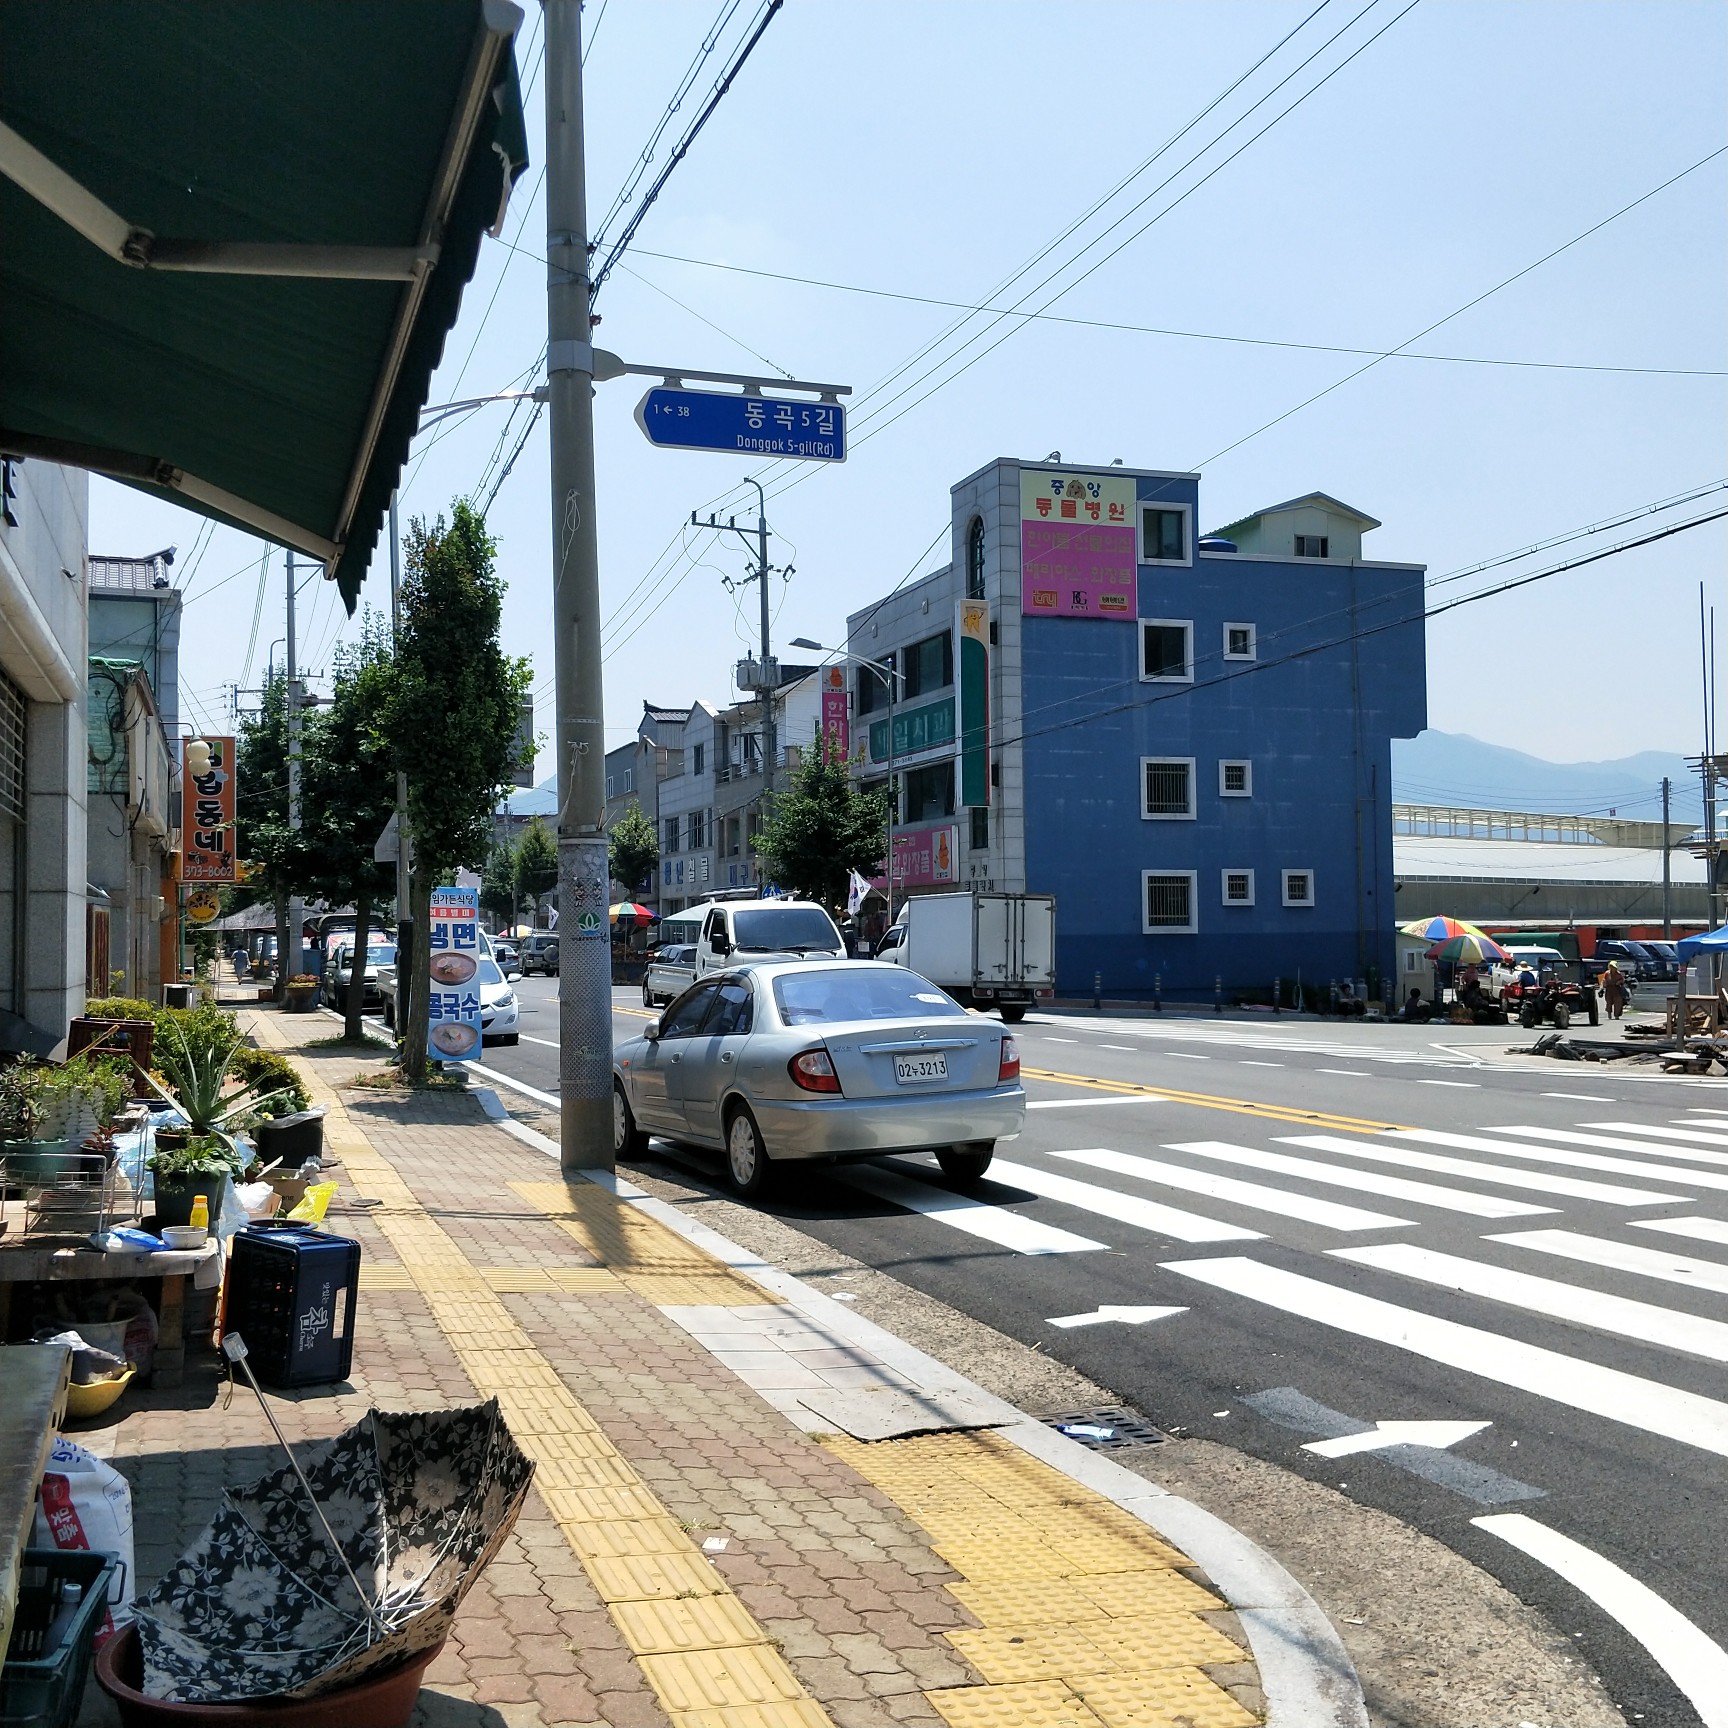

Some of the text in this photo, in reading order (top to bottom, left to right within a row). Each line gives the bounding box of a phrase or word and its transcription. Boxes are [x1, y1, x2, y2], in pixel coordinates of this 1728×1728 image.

[654, 404, 690, 417] 1 38
[737, 435, 834, 458] Donggok 5-gil(Rd)
[1036, 498, 1125, 521] 동물병원
[185, 865, 233, 877] 373-8002
[430, 923, 476, 949] 냉면
[429, 993, 479, 1020] 콩국수
